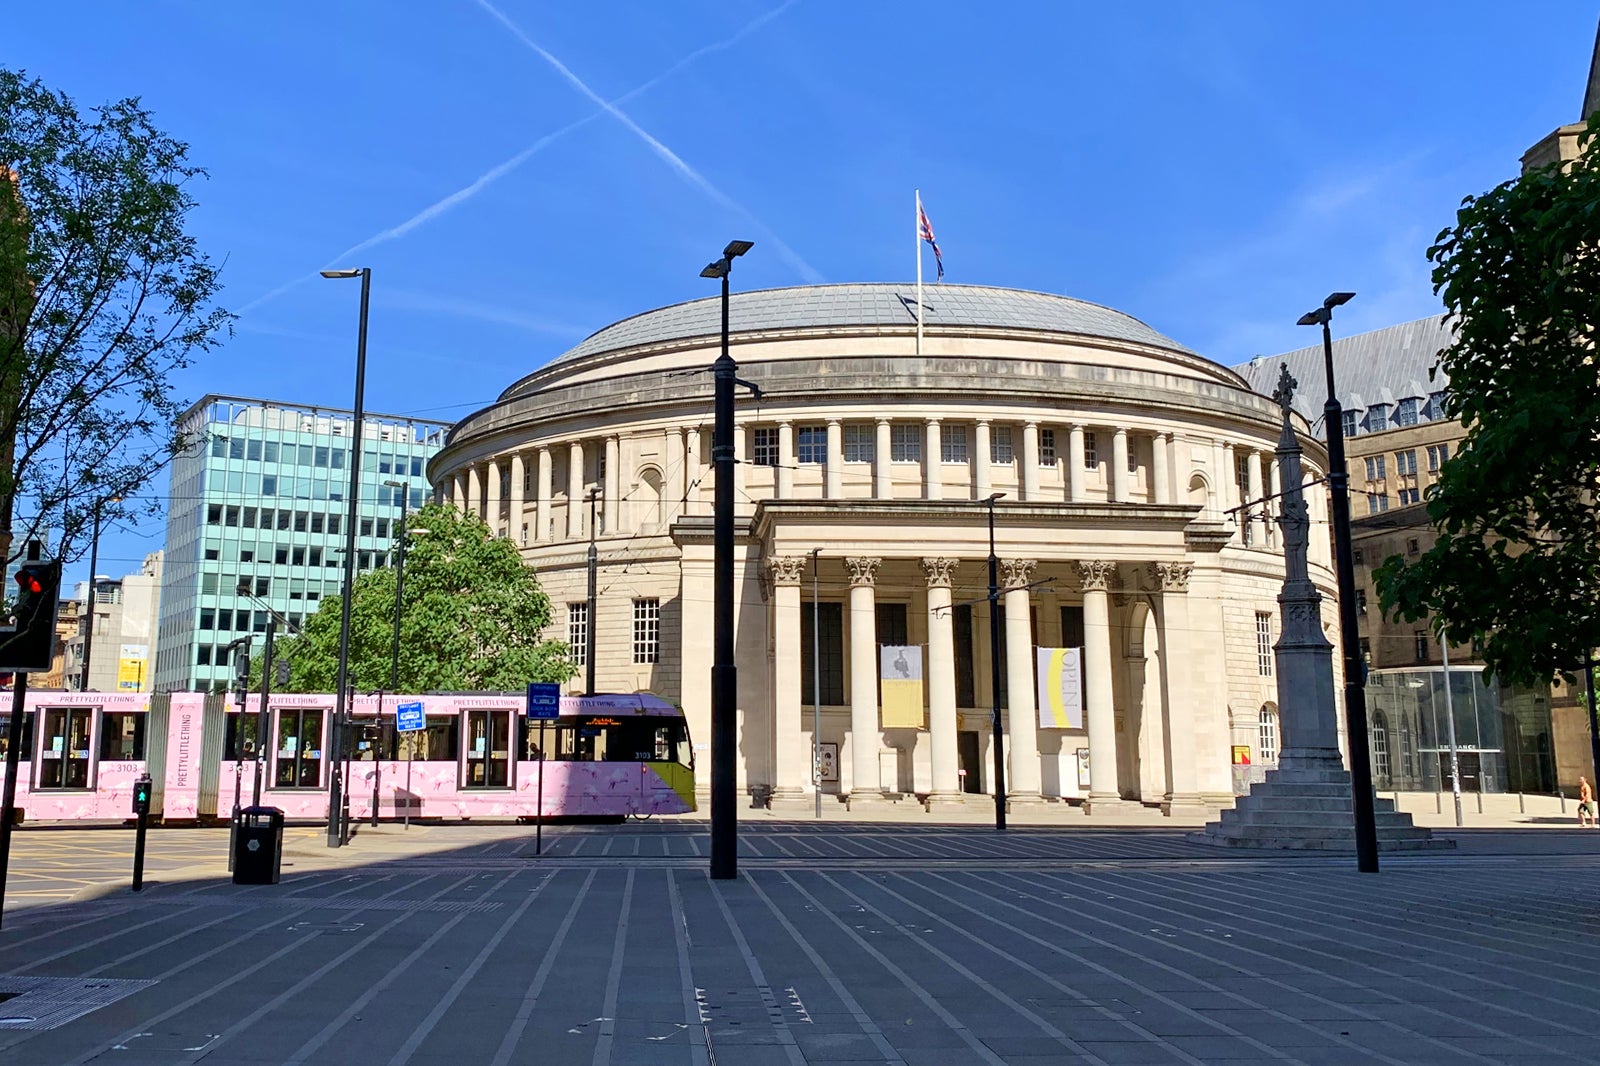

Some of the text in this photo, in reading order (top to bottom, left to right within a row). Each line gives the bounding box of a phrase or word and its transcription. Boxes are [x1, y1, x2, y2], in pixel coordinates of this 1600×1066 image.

[1062, 651, 1077, 707] OPEN
[60, 695, 135, 703] PRETTYLITTLETHING
[178, 714, 191, 786] PRETTYLITTLETHING
[117, 764, 138, 772] 3103
[229, 764, 249, 772] 33
